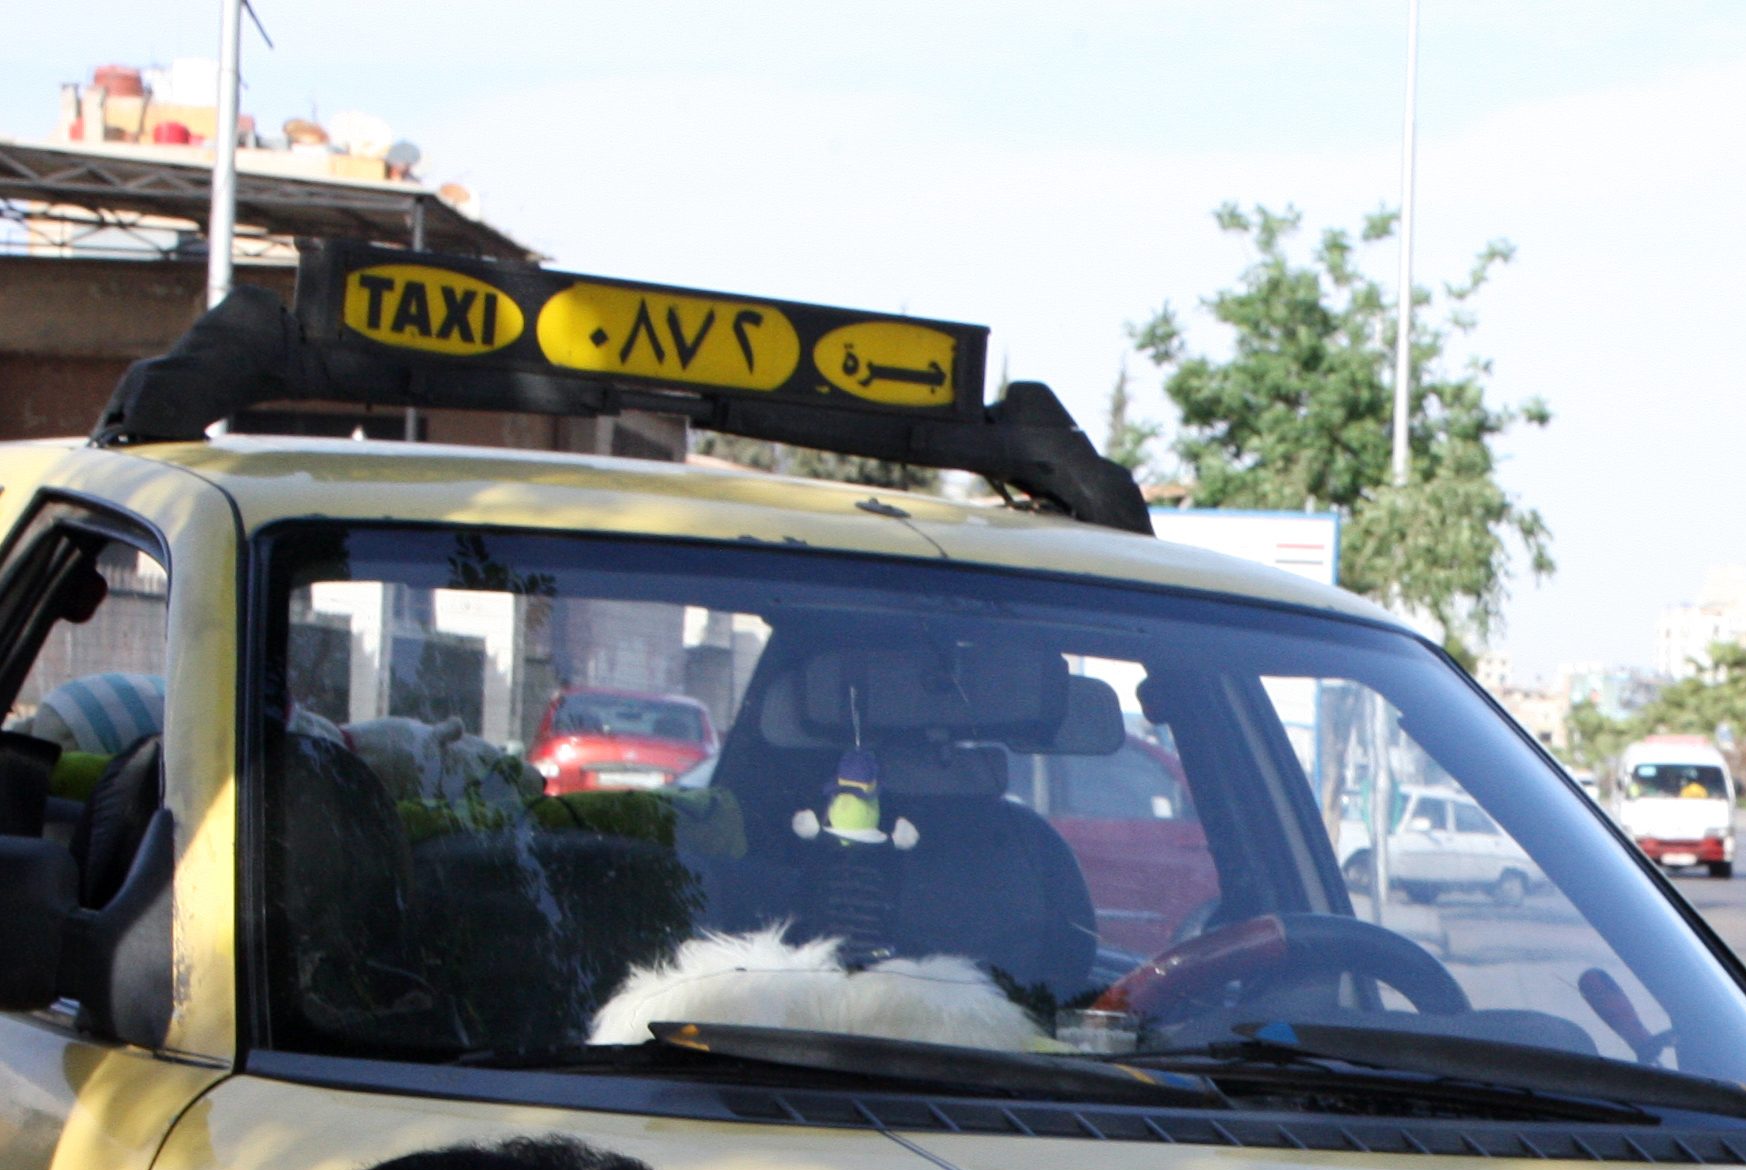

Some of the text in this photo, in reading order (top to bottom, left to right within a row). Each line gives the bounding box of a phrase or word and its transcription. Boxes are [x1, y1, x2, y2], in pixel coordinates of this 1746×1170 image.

[358, 273, 498, 347] TAXI
[588, 297, 764, 375] ٠٨٧٢
[842, 341, 954, 395] جرة
